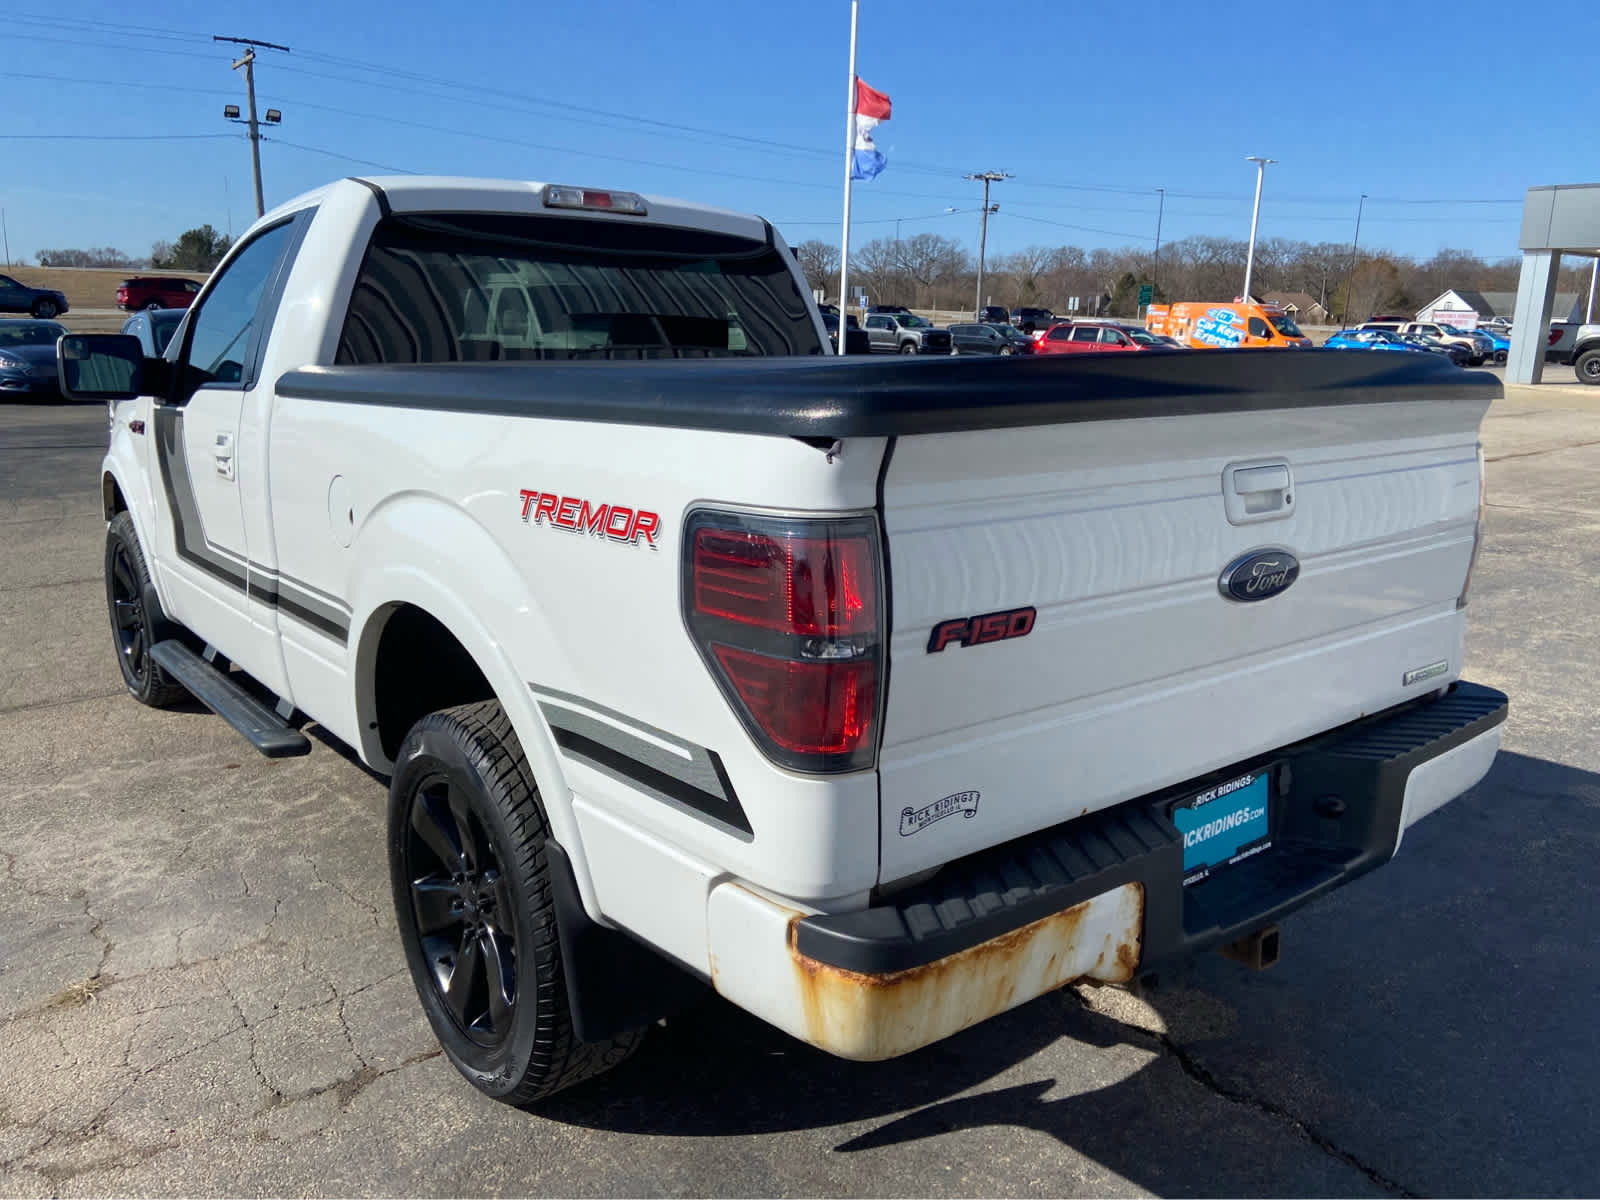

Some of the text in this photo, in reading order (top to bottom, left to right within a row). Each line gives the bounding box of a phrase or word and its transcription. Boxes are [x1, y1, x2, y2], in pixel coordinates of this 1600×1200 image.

[1196, 318, 1245, 342] Car Keys
[520, 489, 660, 549] TREMOR
[1246, 561, 1289, 592] Ford
[927, 606, 1036, 653] F-150
[1195, 775, 1251, 805] RICK RIDINGS
[908, 792, 974, 826] RICK RIDINGS
[1183, 806, 1265, 848] ICKRIDINGS.COM
